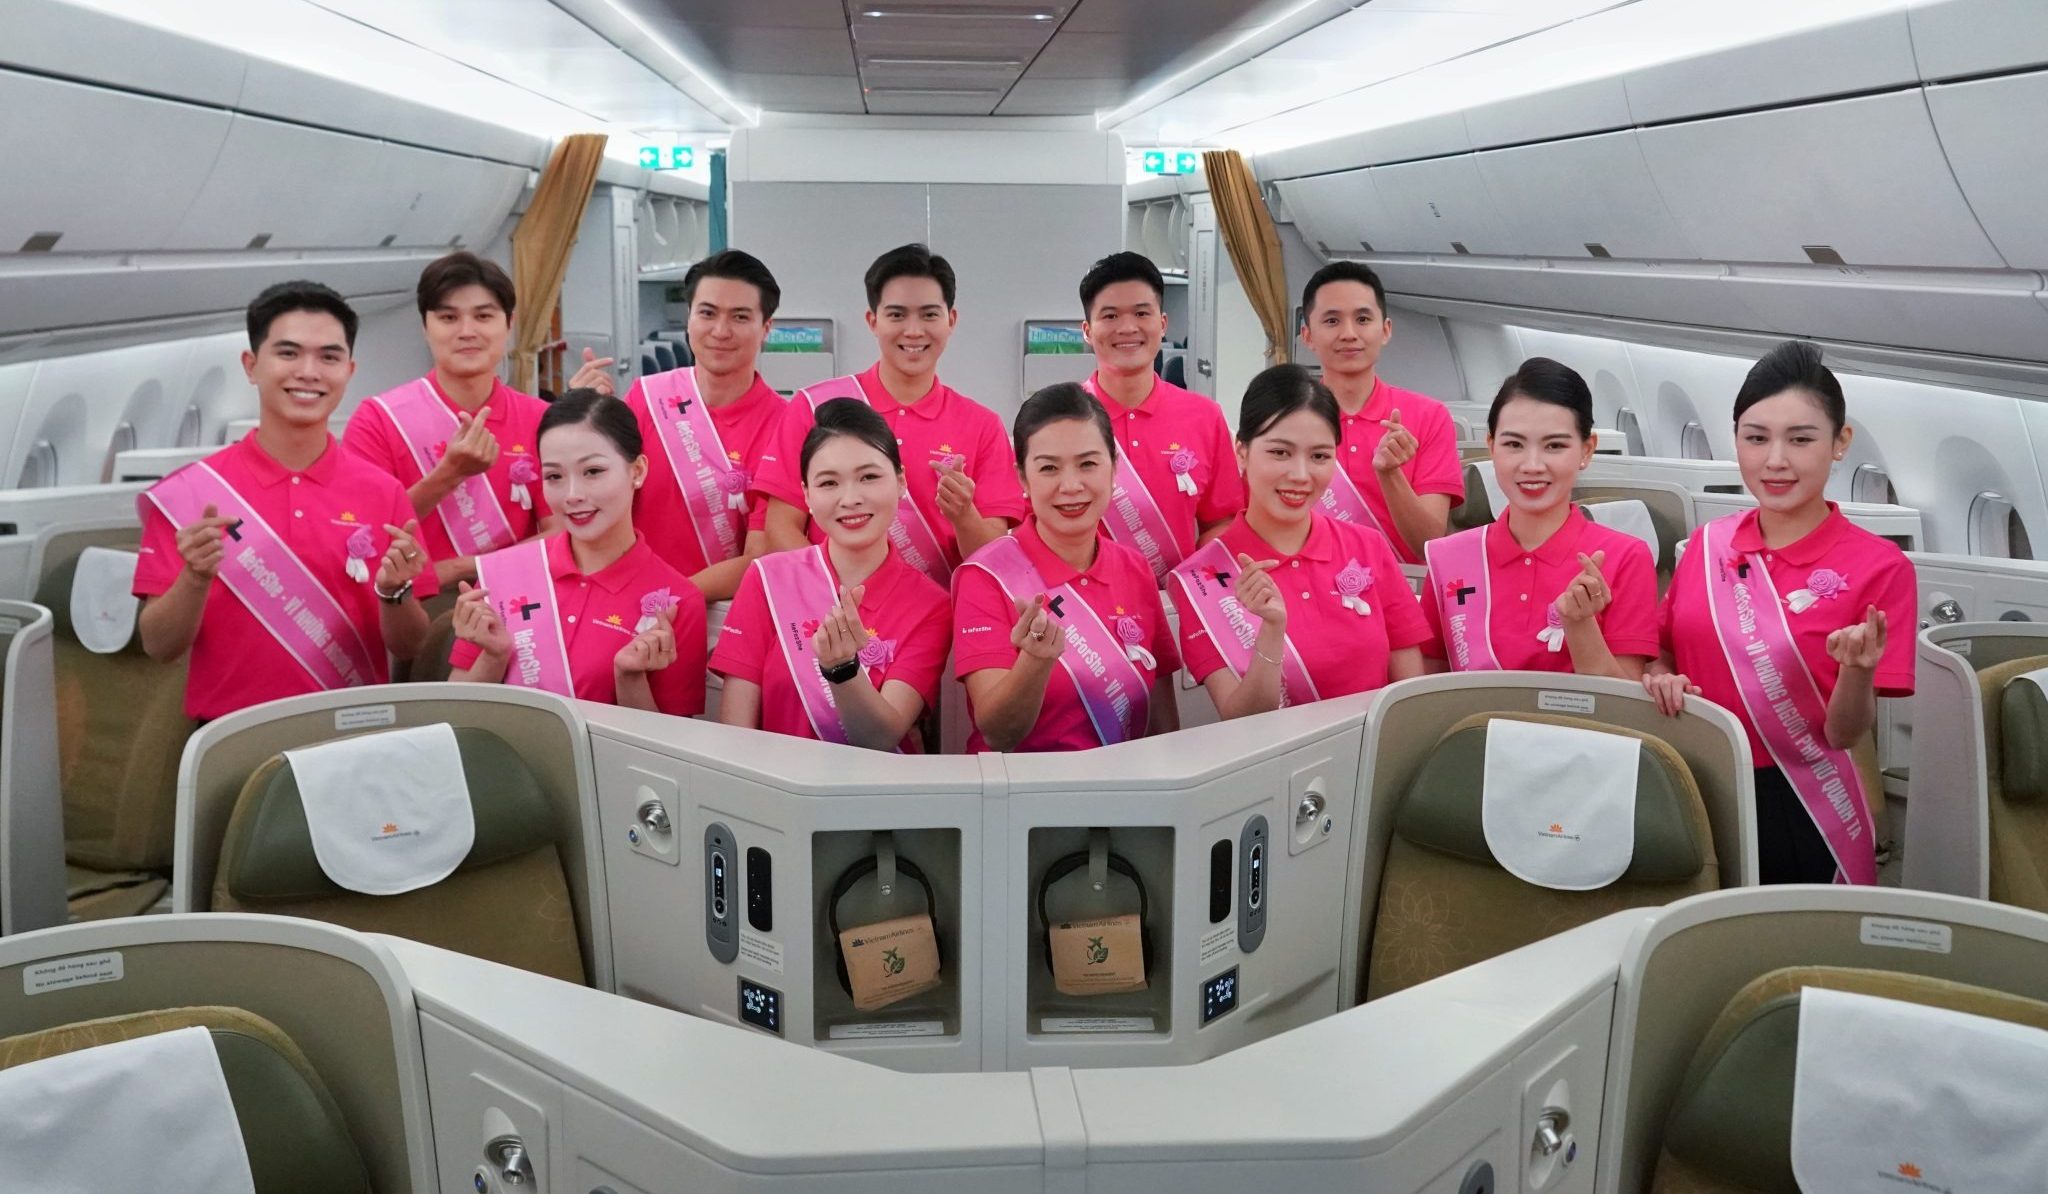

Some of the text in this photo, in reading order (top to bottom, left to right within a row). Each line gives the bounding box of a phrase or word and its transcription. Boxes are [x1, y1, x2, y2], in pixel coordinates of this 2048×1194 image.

[676, 420, 702, 463] HeForShe
[237, 546, 284, 598] HeForShe
[1219, 595, 1257, 649] HeForShe
[1449, 613, 1469, 667] HeForShe
[514, 629, 541, 685] HeForShe
[1065, 624, 1106, 677] HeForShe
[1104, 679, 1124, 698] VÌ
[1745, 639, 1770, 656] VÌ
[1752, 654, 1788, 701] NHỮNG
[1772, 698, 1808, 739] NGƯỜI
[1794, 734, 1822, 764] PHỤ
[1810, 760, 1838, 780] NỮ
[1820, 777, 1857, 823] QUANH
[1846, 818, 1862, 841] TA
